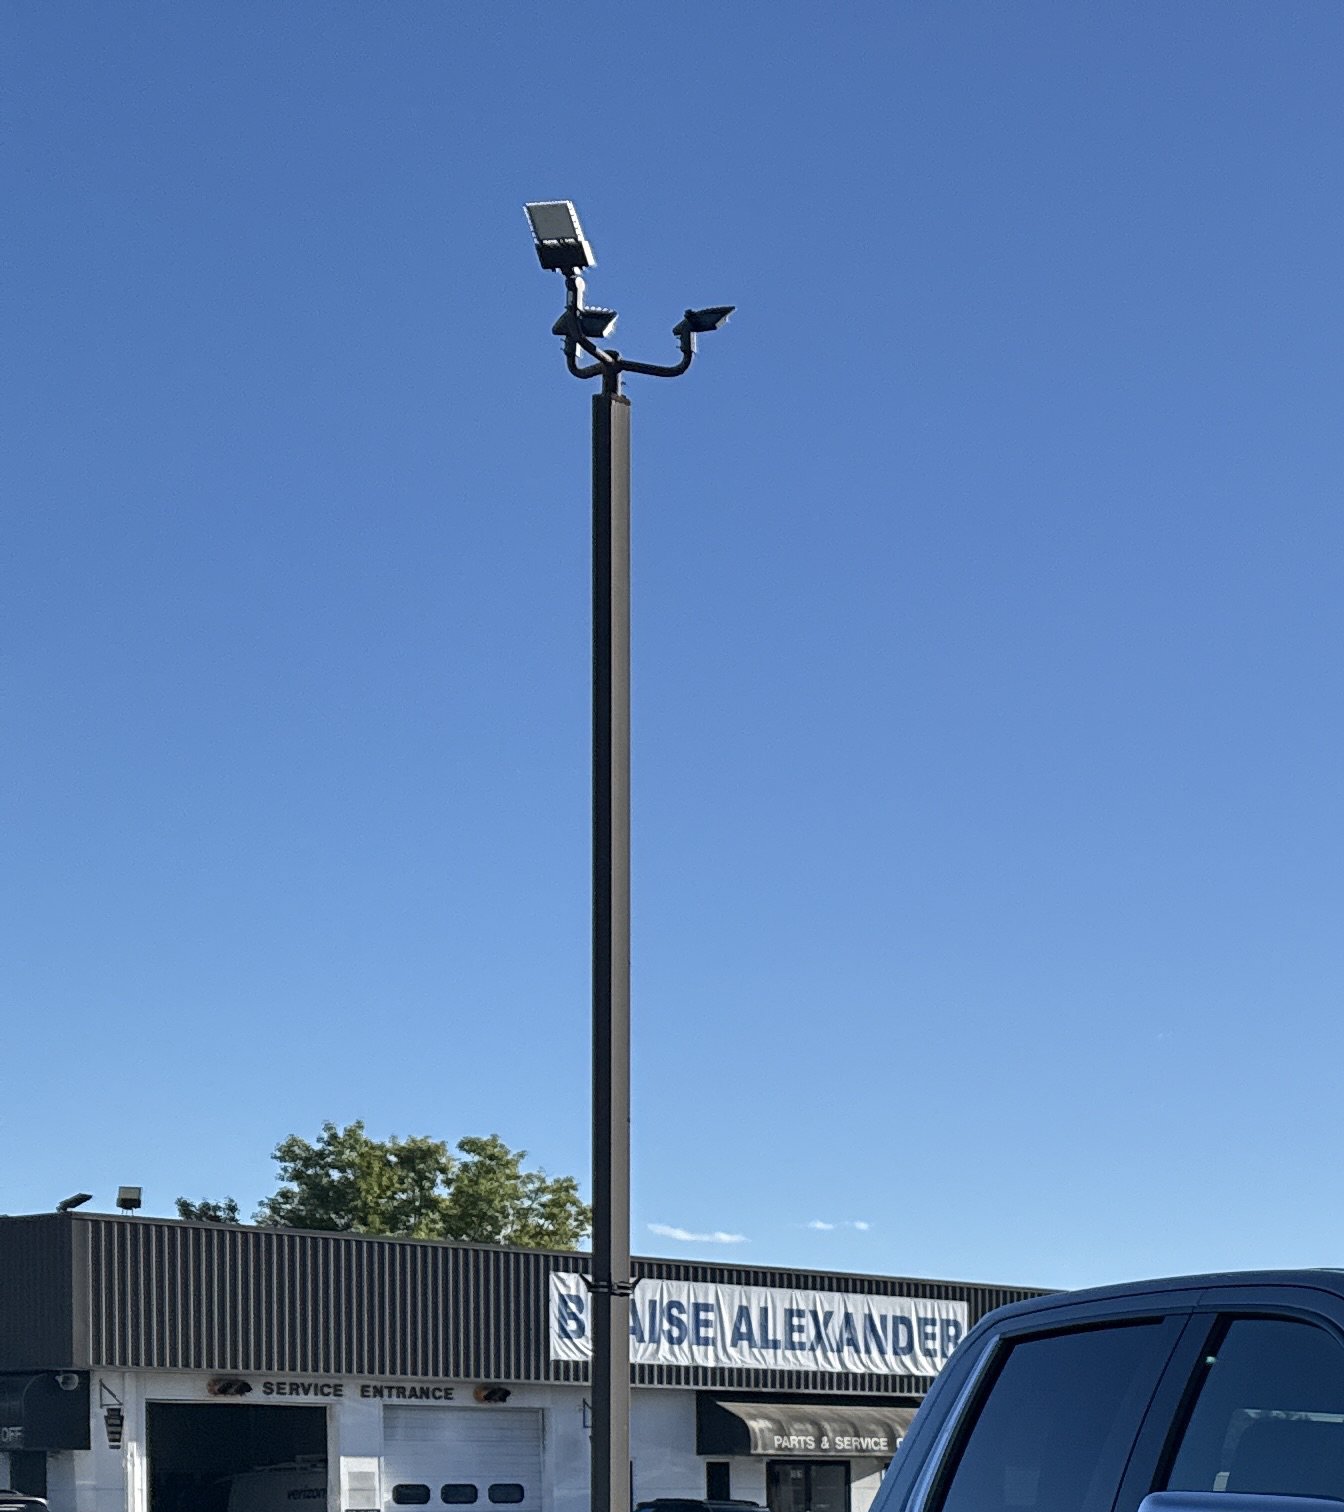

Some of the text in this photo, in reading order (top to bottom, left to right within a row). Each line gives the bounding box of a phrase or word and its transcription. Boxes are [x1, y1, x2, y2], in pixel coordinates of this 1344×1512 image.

[557, 1293, 963, 1358] BAISE ALEXANDER
[262, 1381, 455, 1400] SERVICE ENTRANCE
[774, 1435, 816, 1450] PARTS
[820, 1436, 830, 1450] &
[835, 1436, 889, 1451] SERVICE
